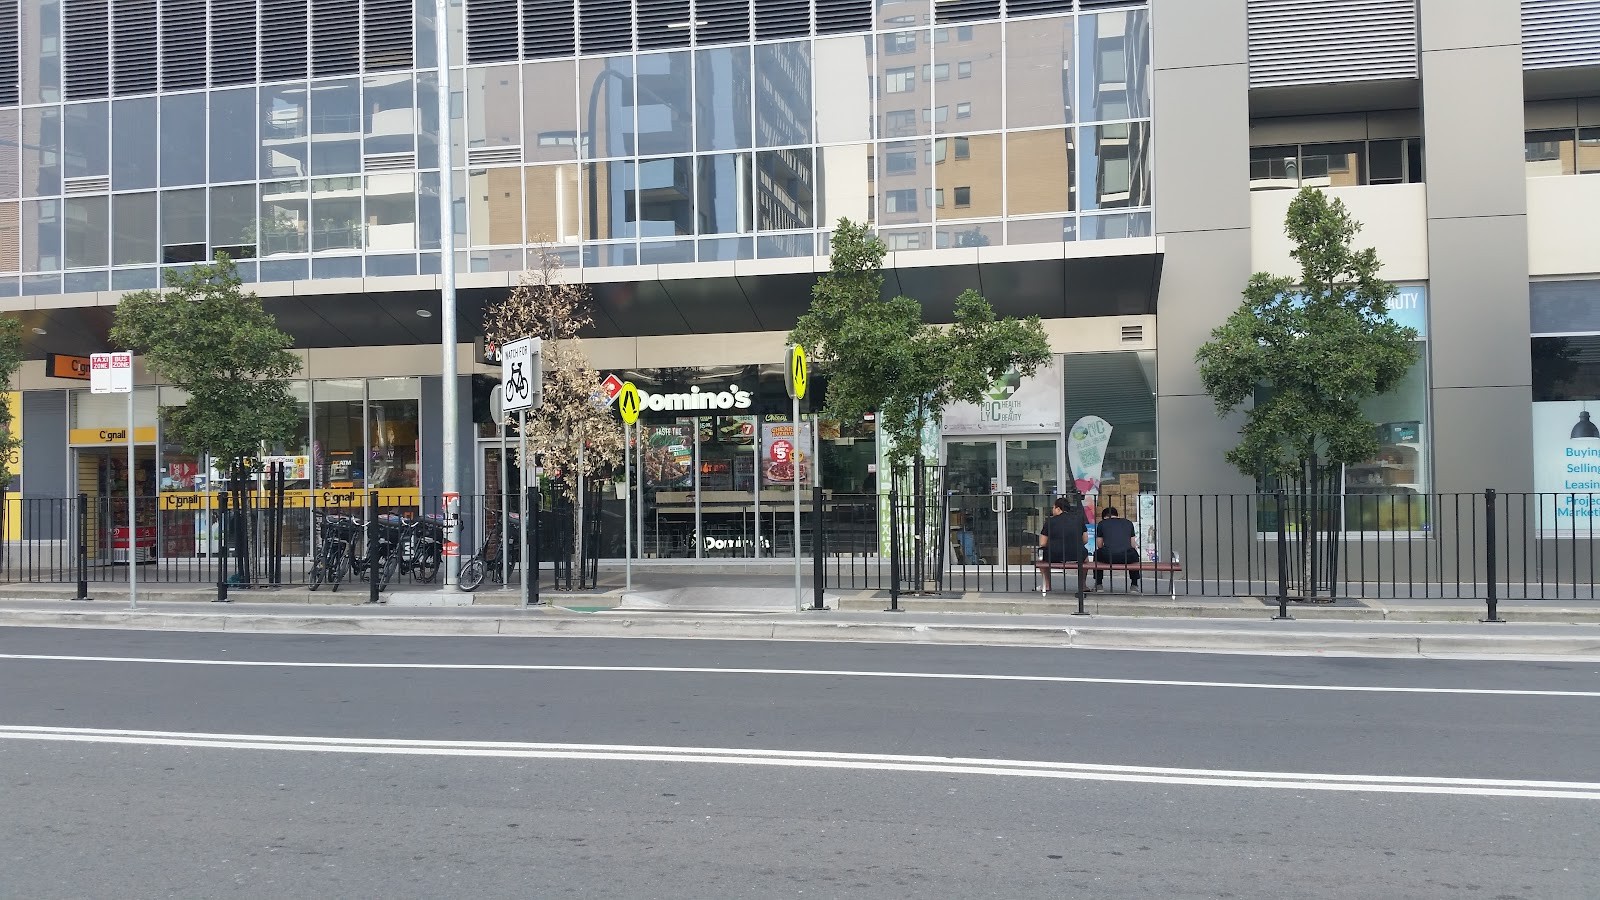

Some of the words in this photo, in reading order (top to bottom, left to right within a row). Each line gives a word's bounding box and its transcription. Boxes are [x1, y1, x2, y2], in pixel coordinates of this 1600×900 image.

[1387, 292, 1419, 310] AUTY
[71, 359, 90, 376] Cign
[638, 384, 752, 411] Domino's
[1566, 447, 1600, 458] Buyin
